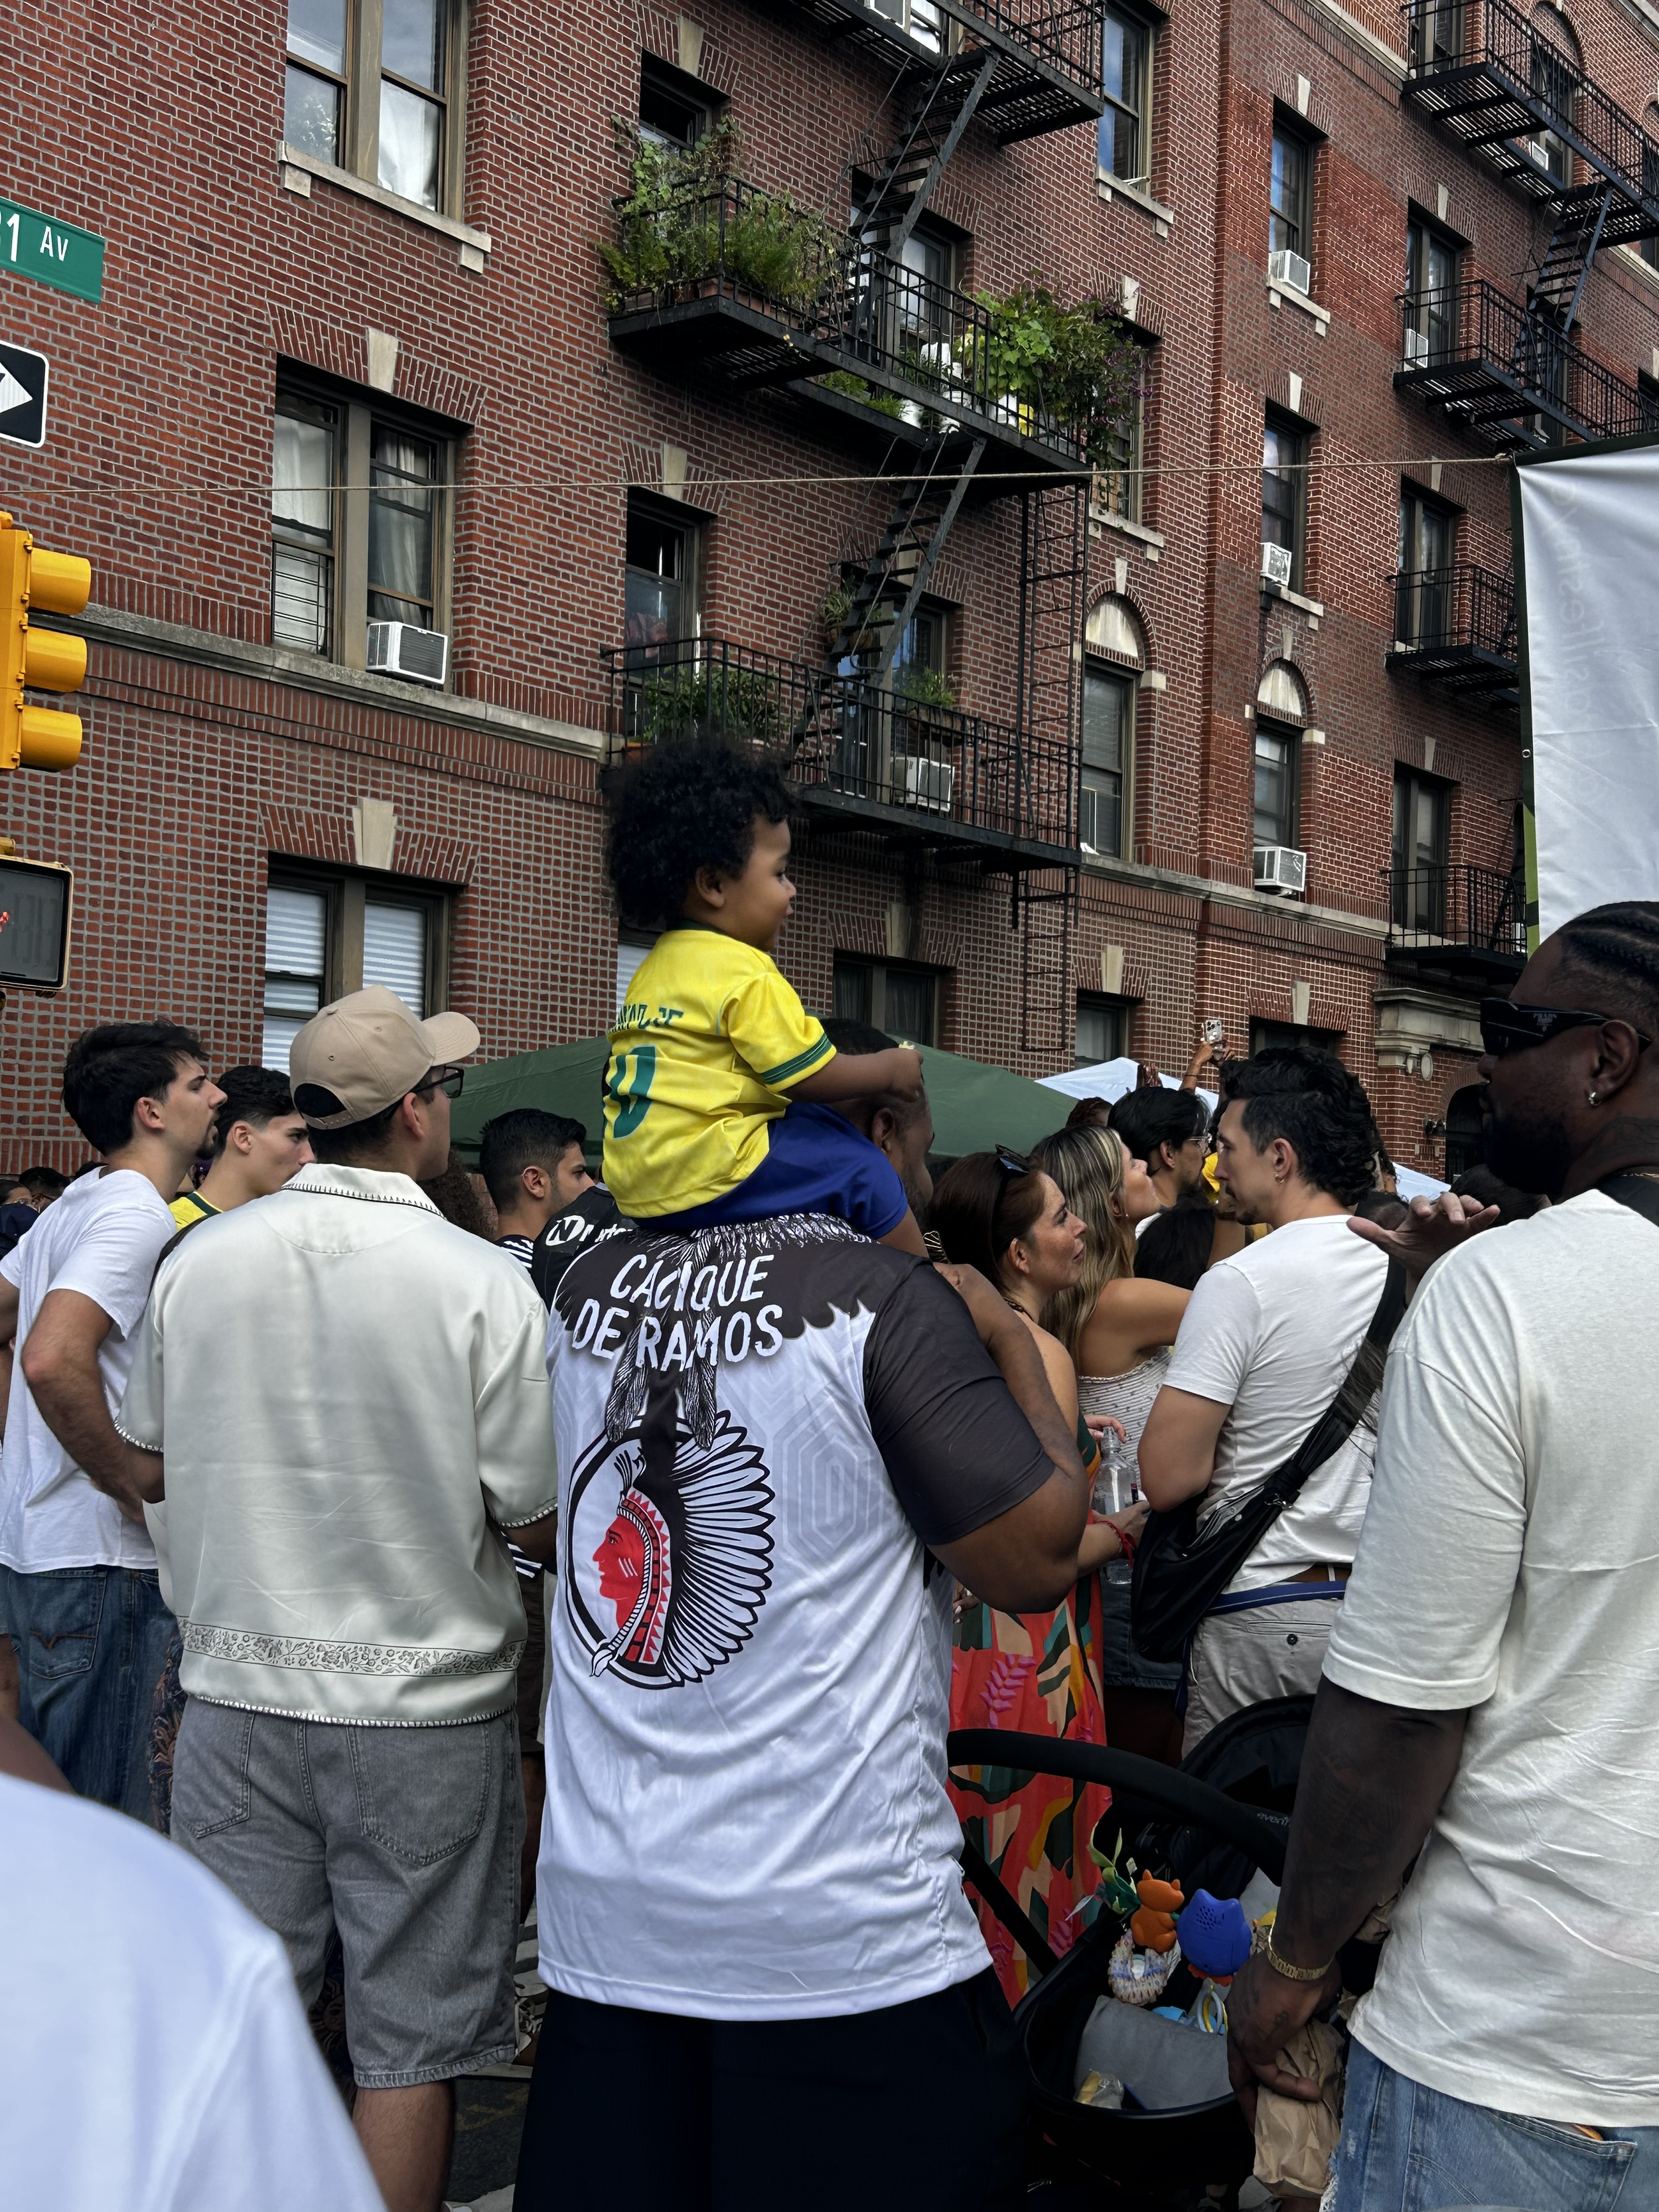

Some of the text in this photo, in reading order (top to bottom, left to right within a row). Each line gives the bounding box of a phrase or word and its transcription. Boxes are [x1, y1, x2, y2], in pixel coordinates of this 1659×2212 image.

[0, 211, 20, 262] 1
[602, 1043, 657, 1140] 0
[610, 1254, 775, 1311] CACIQUE
[571, 1299, 783, 1372] DE RAMOS
[1257, 1812, 1291, 1827] evenf
